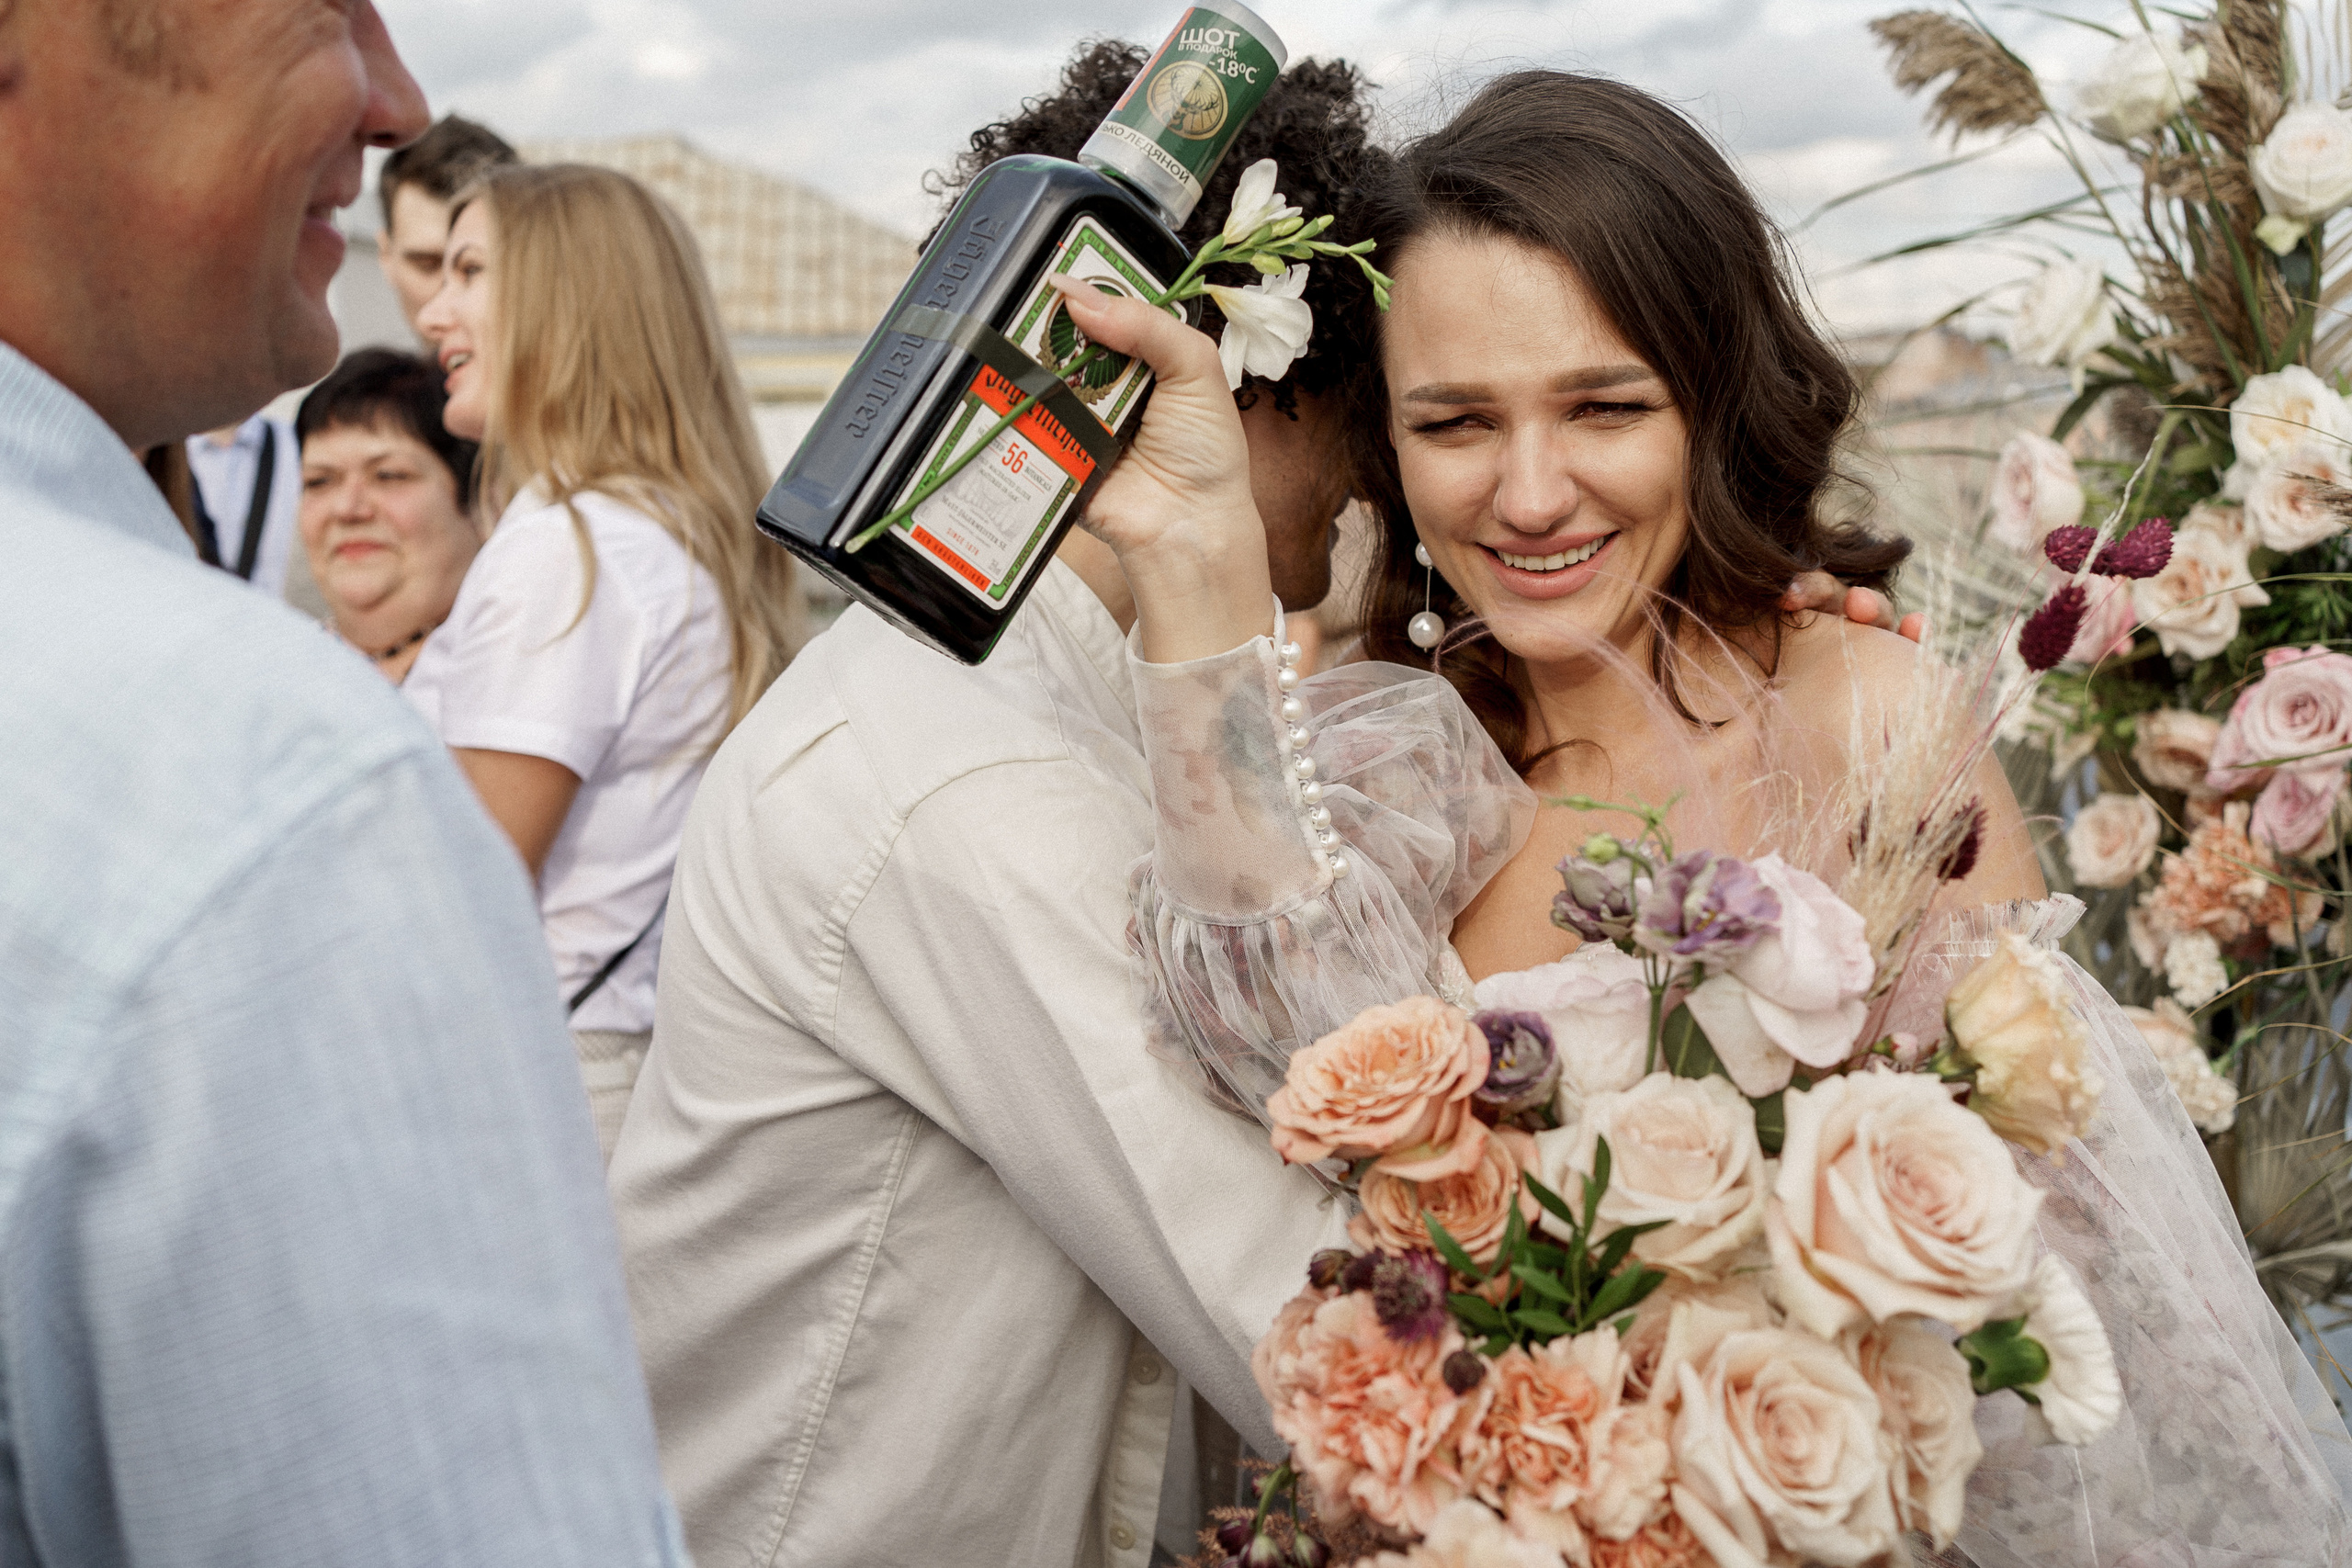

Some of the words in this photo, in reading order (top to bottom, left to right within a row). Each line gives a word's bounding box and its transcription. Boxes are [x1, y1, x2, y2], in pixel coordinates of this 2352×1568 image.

[1178, 43, 1185, 51] В
[1185, 44, 1238, 60] ПОДАРОК
[1180, 28, 1240, 50] ШОТ
[1101, 122, 1125, 137] ЬКО
[1123, 131, 1191, 184] ЛЕДЯНОЙ
[999, 441, 1030, 475] 56
